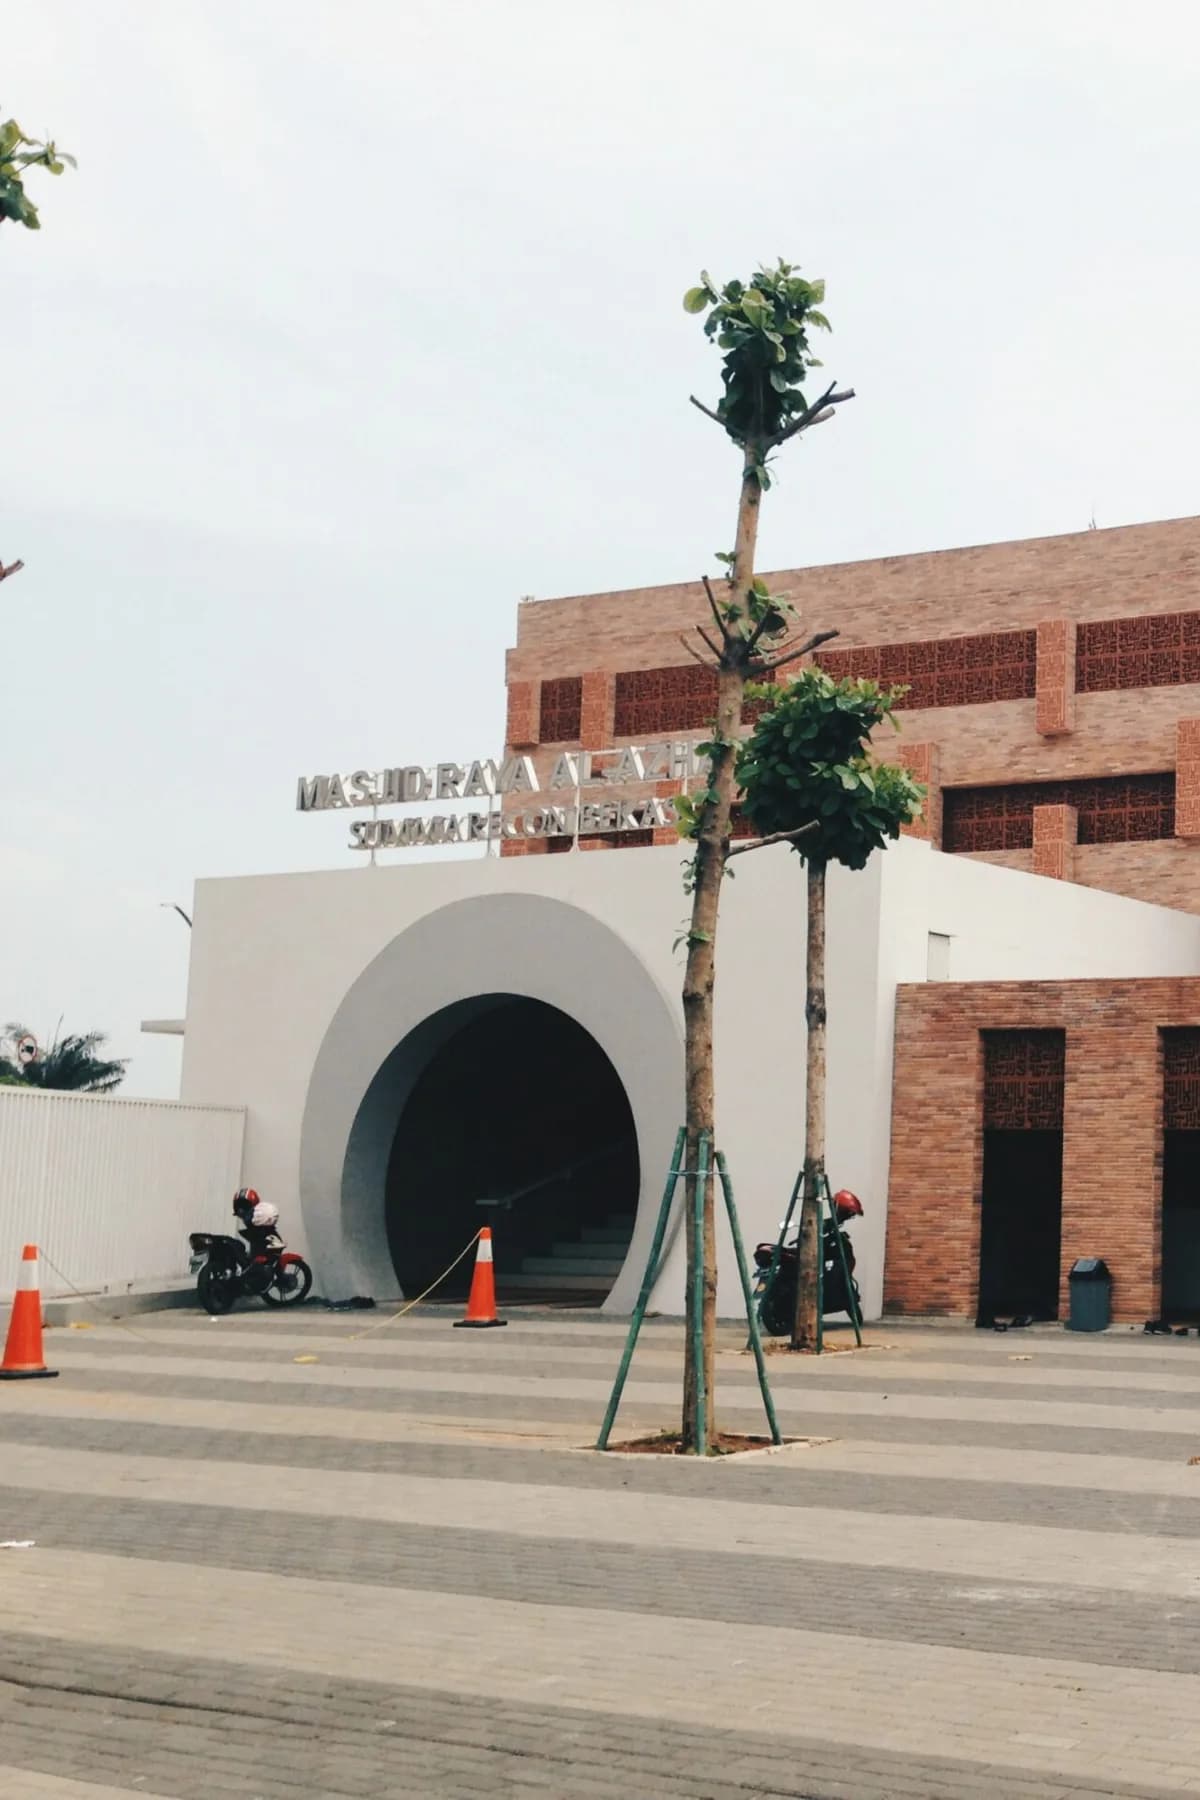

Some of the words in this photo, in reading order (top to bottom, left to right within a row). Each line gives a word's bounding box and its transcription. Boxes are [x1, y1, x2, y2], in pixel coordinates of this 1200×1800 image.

[296, 765, 430, 812] MASJID
[437, 756, 538, 799] RAYA
[348, 805, 574, 850] SUMMARECON
[579, 797, 681, 832] BEKAS
